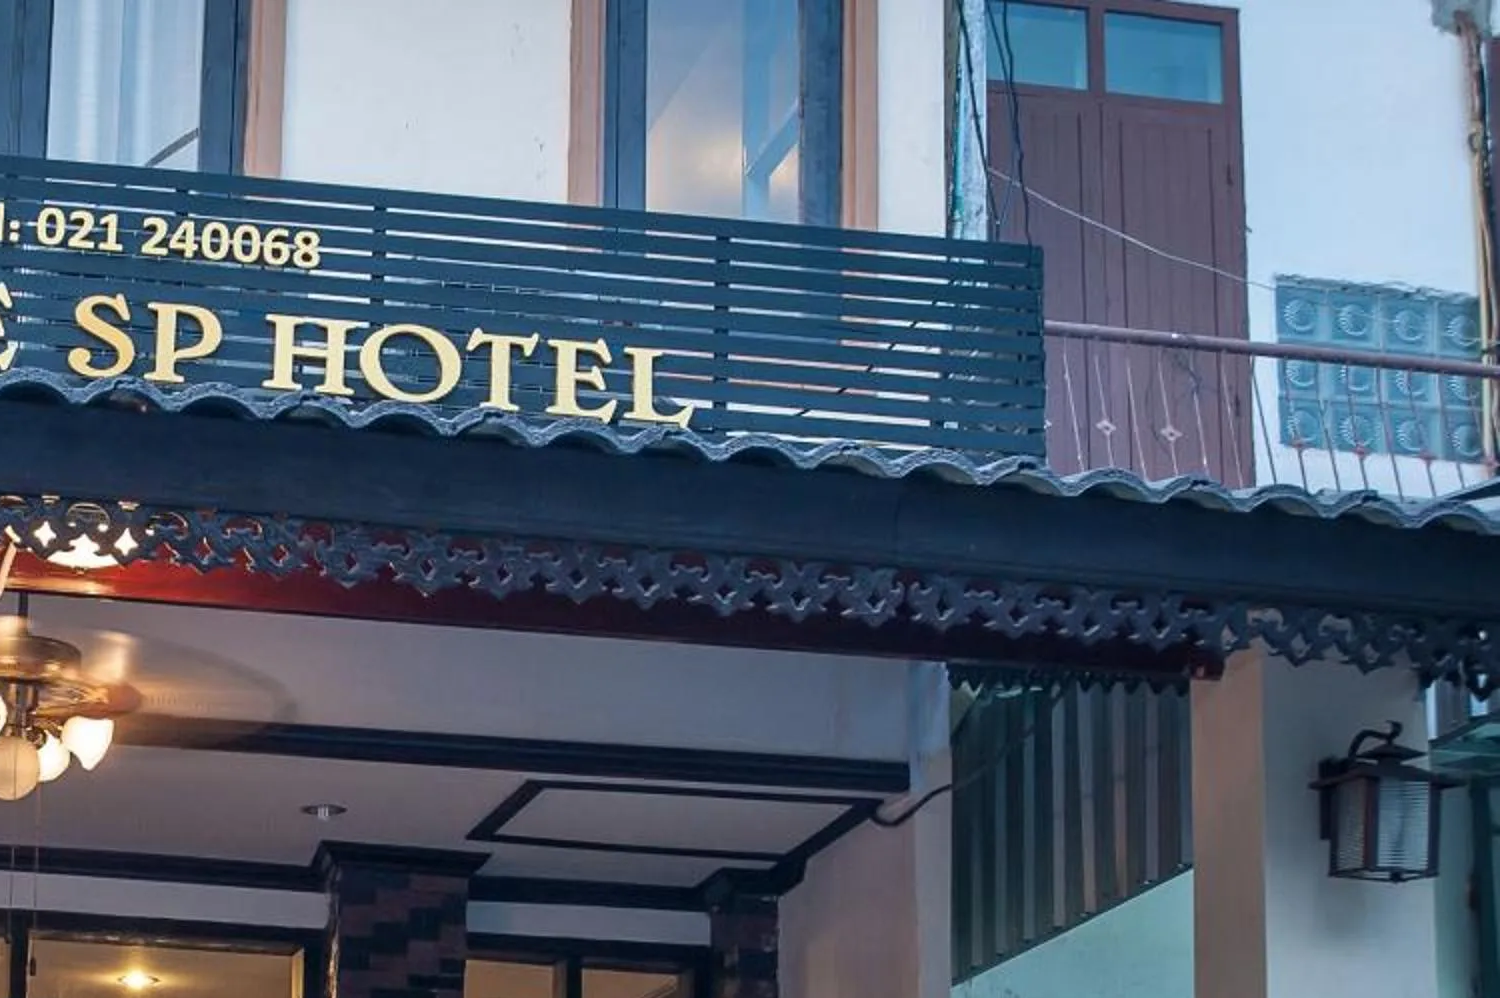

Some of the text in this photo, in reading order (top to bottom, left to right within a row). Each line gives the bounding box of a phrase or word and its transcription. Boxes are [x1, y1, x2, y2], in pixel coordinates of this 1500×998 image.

[36, 207, 124, 252] 021
[141, 215, 321, 270] 240068
[67, 293, 223, 383] SP
[262, 313, 695, 429] HOTEL
